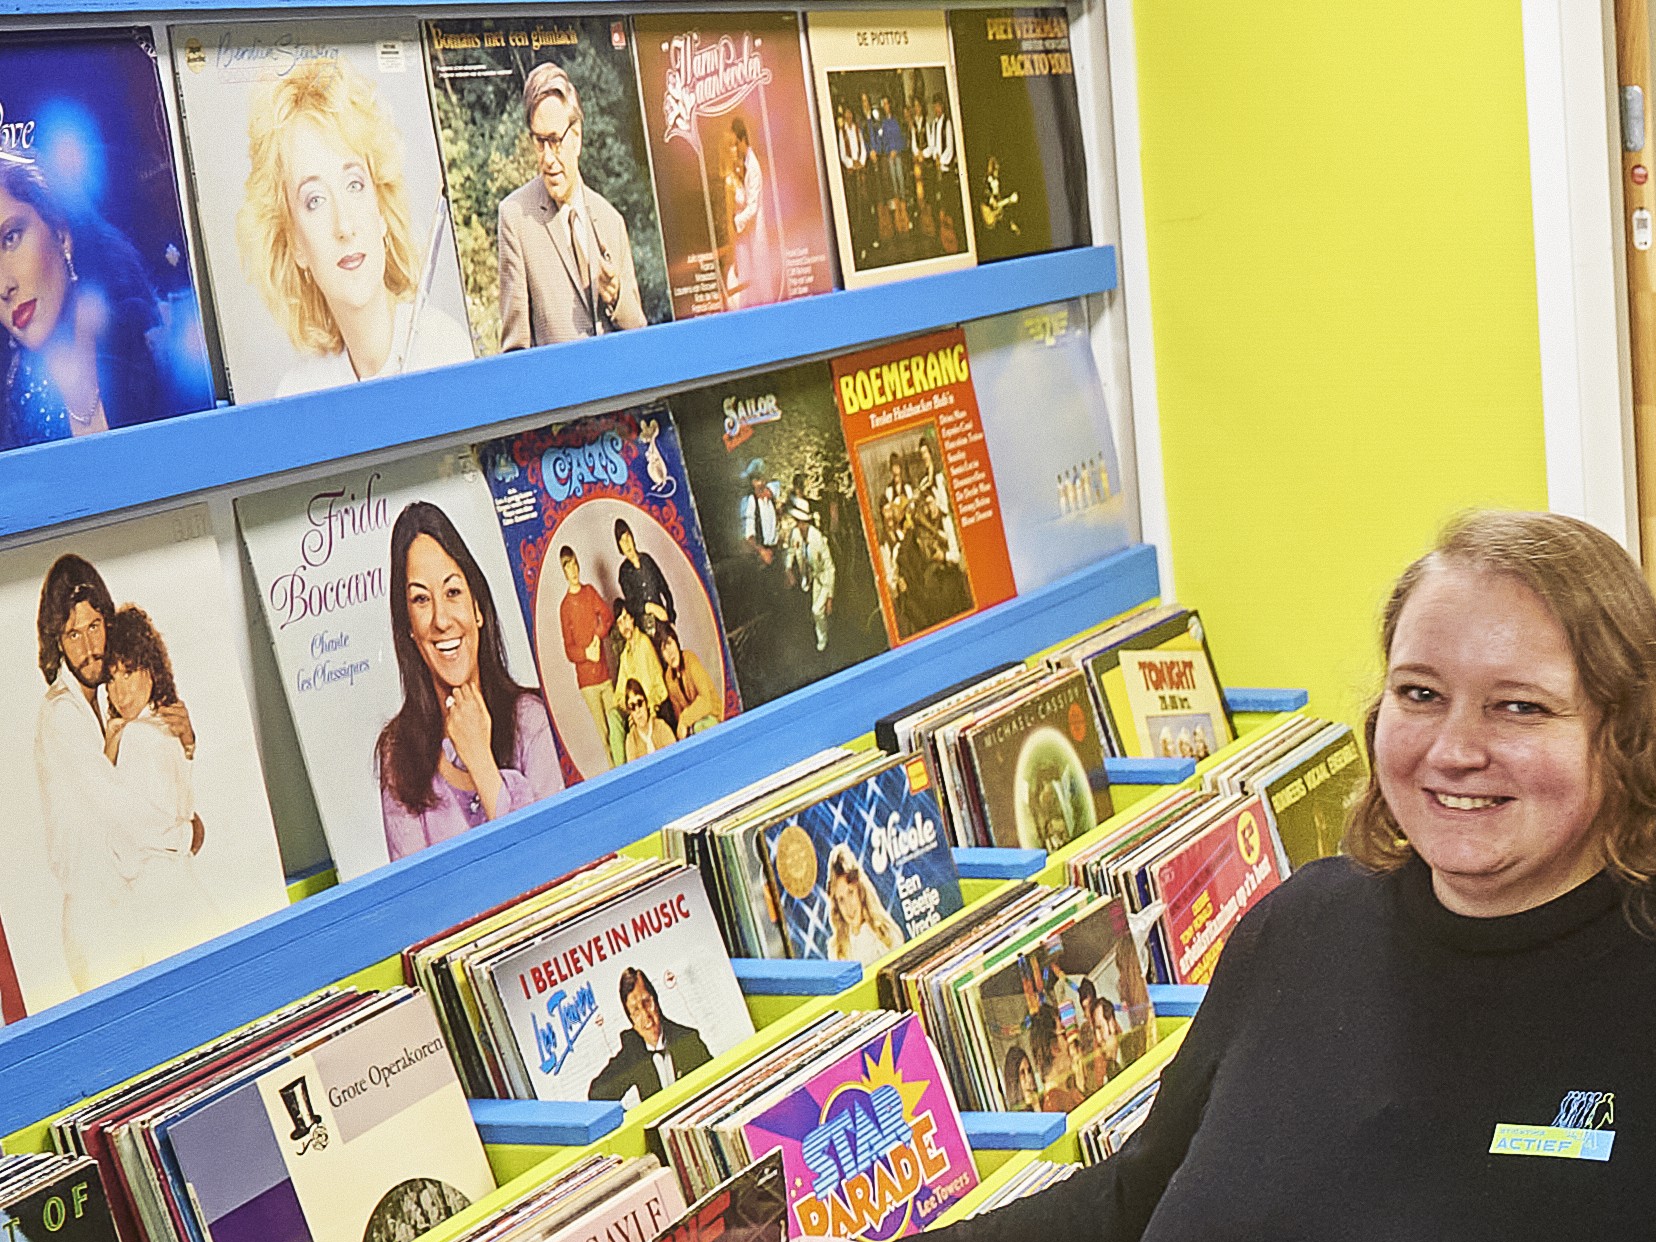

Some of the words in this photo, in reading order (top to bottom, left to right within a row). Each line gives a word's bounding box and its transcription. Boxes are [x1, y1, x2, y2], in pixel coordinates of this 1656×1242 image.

[839, 343, 969, 415] BOEMERANG
[723, 393, 783, 437] SAILOR
[542, 431, 629, 502] CATS
[302, 473, 389, 566] Frida
[270, 565, 385, 630] Boccara
[1138, 660, 1196, 691] TONIGHT
[871, 811, 937, 874] Nicole
[898, 874, 921, 899] Een
[902, 886, 941, 921] Beetje
[520, 974, 532, 1000] I
[533, 936, 608, 994] BELIEVE
[606, 924, 630, 957] IN
[632, 894, 692, 942] MUSIC
[328, 1078, 369, 1109] Grote
[368, 1036, 444, 1090] Operakoren
[793, 1109, 951, 1239] PARADE
[802, 1084, 914, 1202] STAR
[1496, 1137, 1573, 1153] ACTIEF
[916, 1197, 936, 1218] Lee
[933, 1171, 970, 1207] Towers
